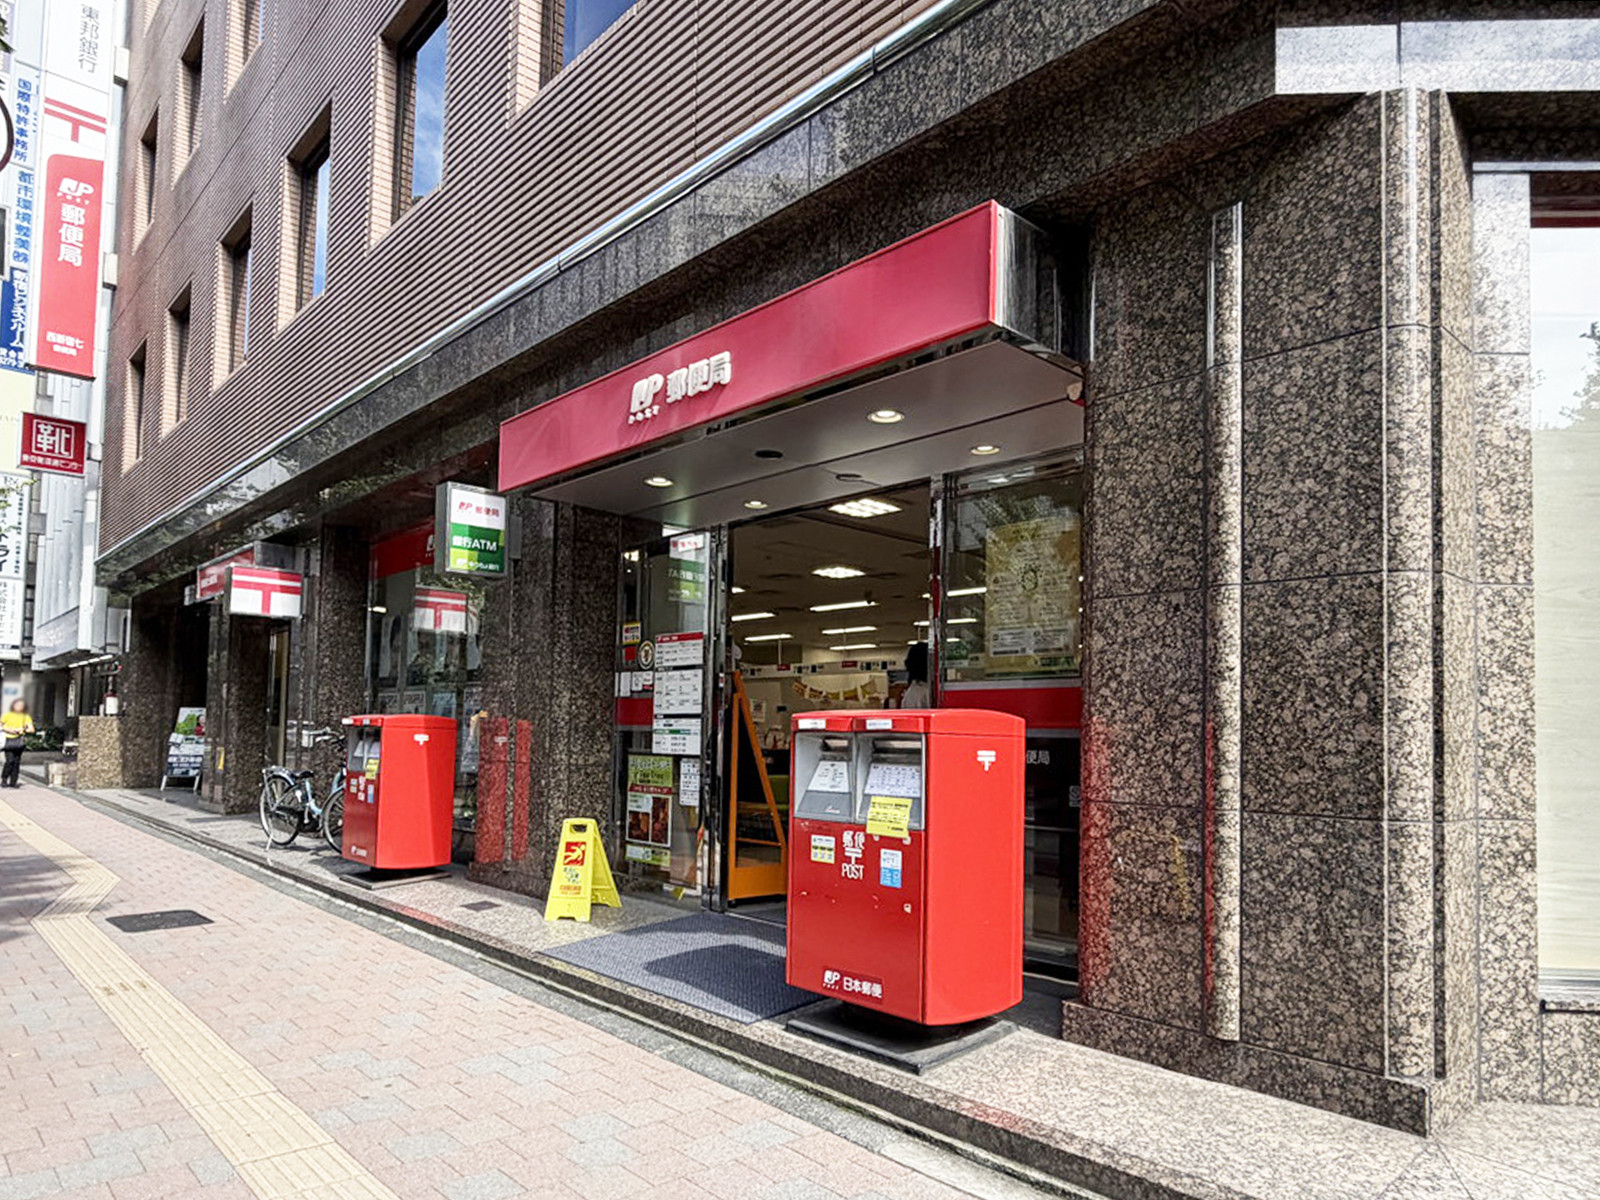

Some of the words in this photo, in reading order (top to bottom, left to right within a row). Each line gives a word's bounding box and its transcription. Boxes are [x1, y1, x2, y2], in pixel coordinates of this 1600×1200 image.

[58, 204, 86, 267] 郵便局
[666, 351, 731, 403] 郵便局
[37, 424, 70, 457] 靴
[452, 535, 497, 551] 銀行ATM
[842, 831, 866, 849] 郵便
[841, 862, 865, 880] POST
[843, 976, 882, 998] 日本郵便
